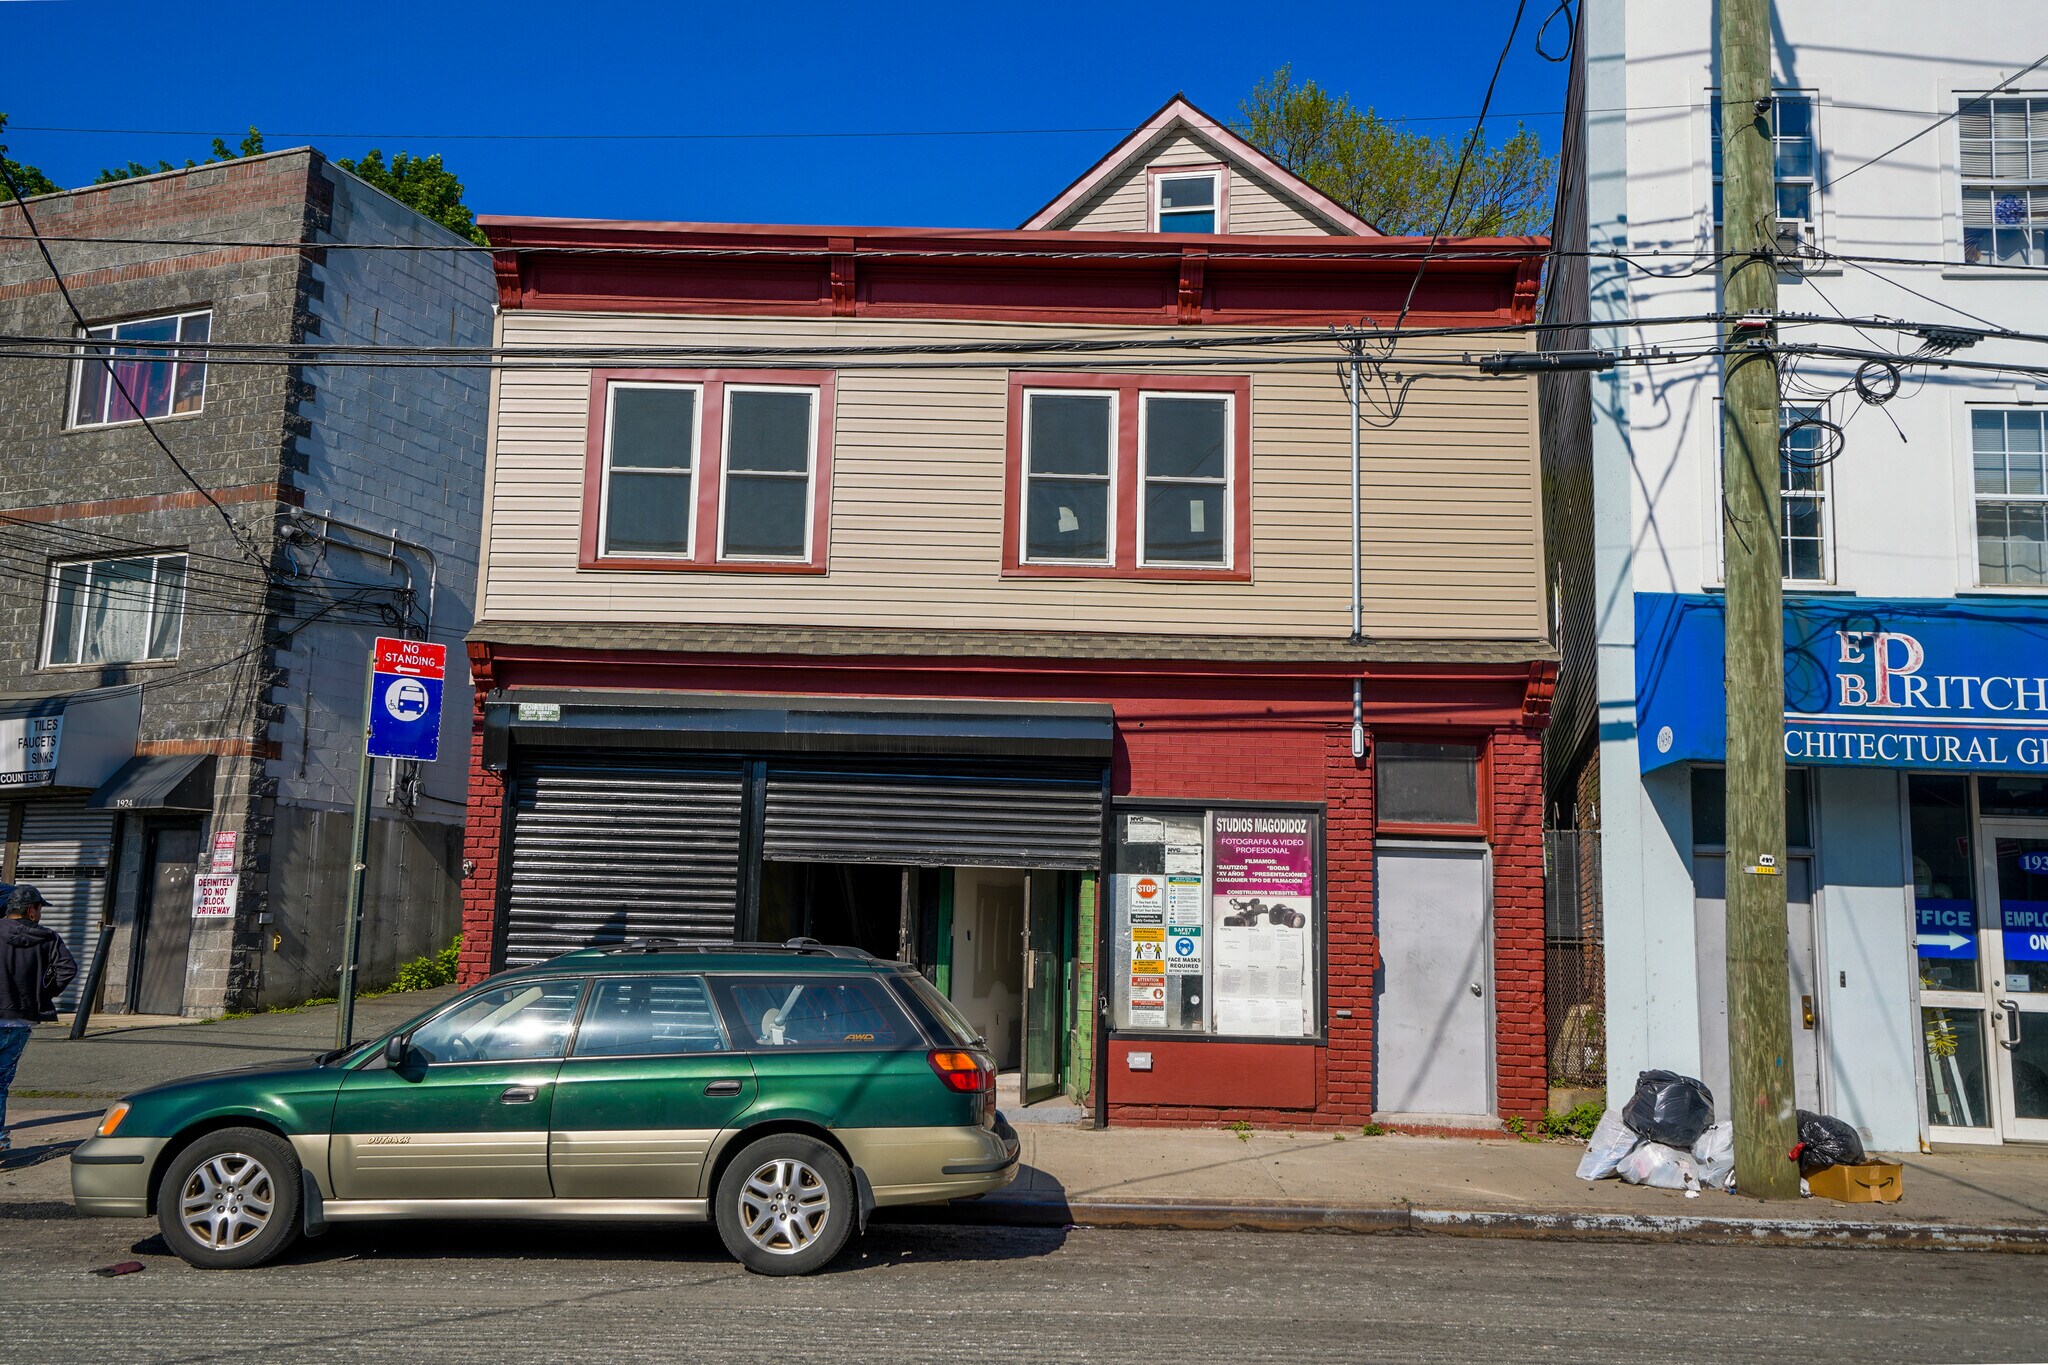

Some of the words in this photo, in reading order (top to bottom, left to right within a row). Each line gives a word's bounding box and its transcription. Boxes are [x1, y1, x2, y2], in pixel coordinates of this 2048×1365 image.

[403, 644, 419, 654] NO
[385, 653, 436, 666] STANDING
[34, 719, 58, 732] TILES
[18, 736, 56, 749] FAUCETS
[1658, 732, 1672, 748] 1936
[32, 752, 54, 764] SINKS
[116, 800, 132, 808] 1924
[1216, 818, 1253, 832] STUDIOS
[1254, 818, 1306, 833] MAGODIDOZ
[198, 878, 234, 886] DEFINITELY
[197, 906, 230, 914] DRIVEWAY
[367, 1136, 410, 1144] OUTBACK
